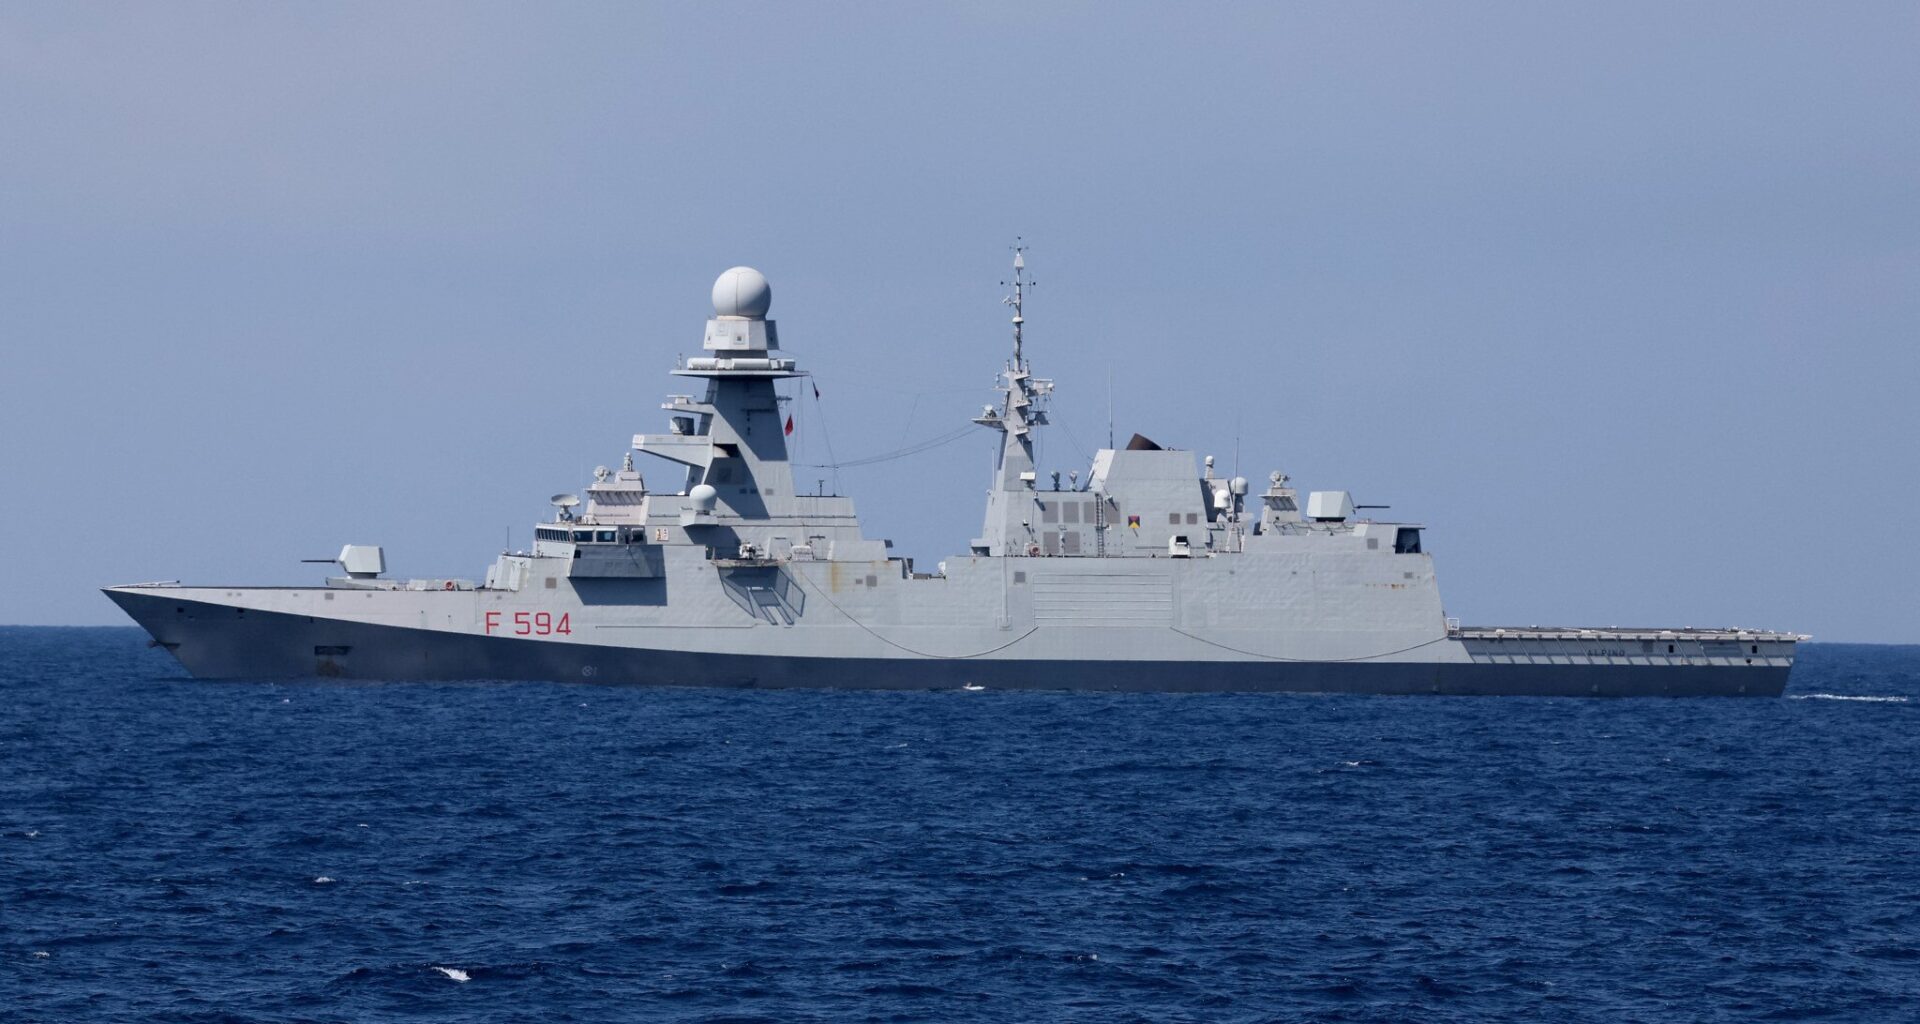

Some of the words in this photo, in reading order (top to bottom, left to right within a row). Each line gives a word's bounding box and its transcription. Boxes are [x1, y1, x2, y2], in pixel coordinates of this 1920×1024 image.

[485, 612, 501, 635] F
[514, 612, 572, 636] 594
[1587, 649, 1625, 657] ALPINO
